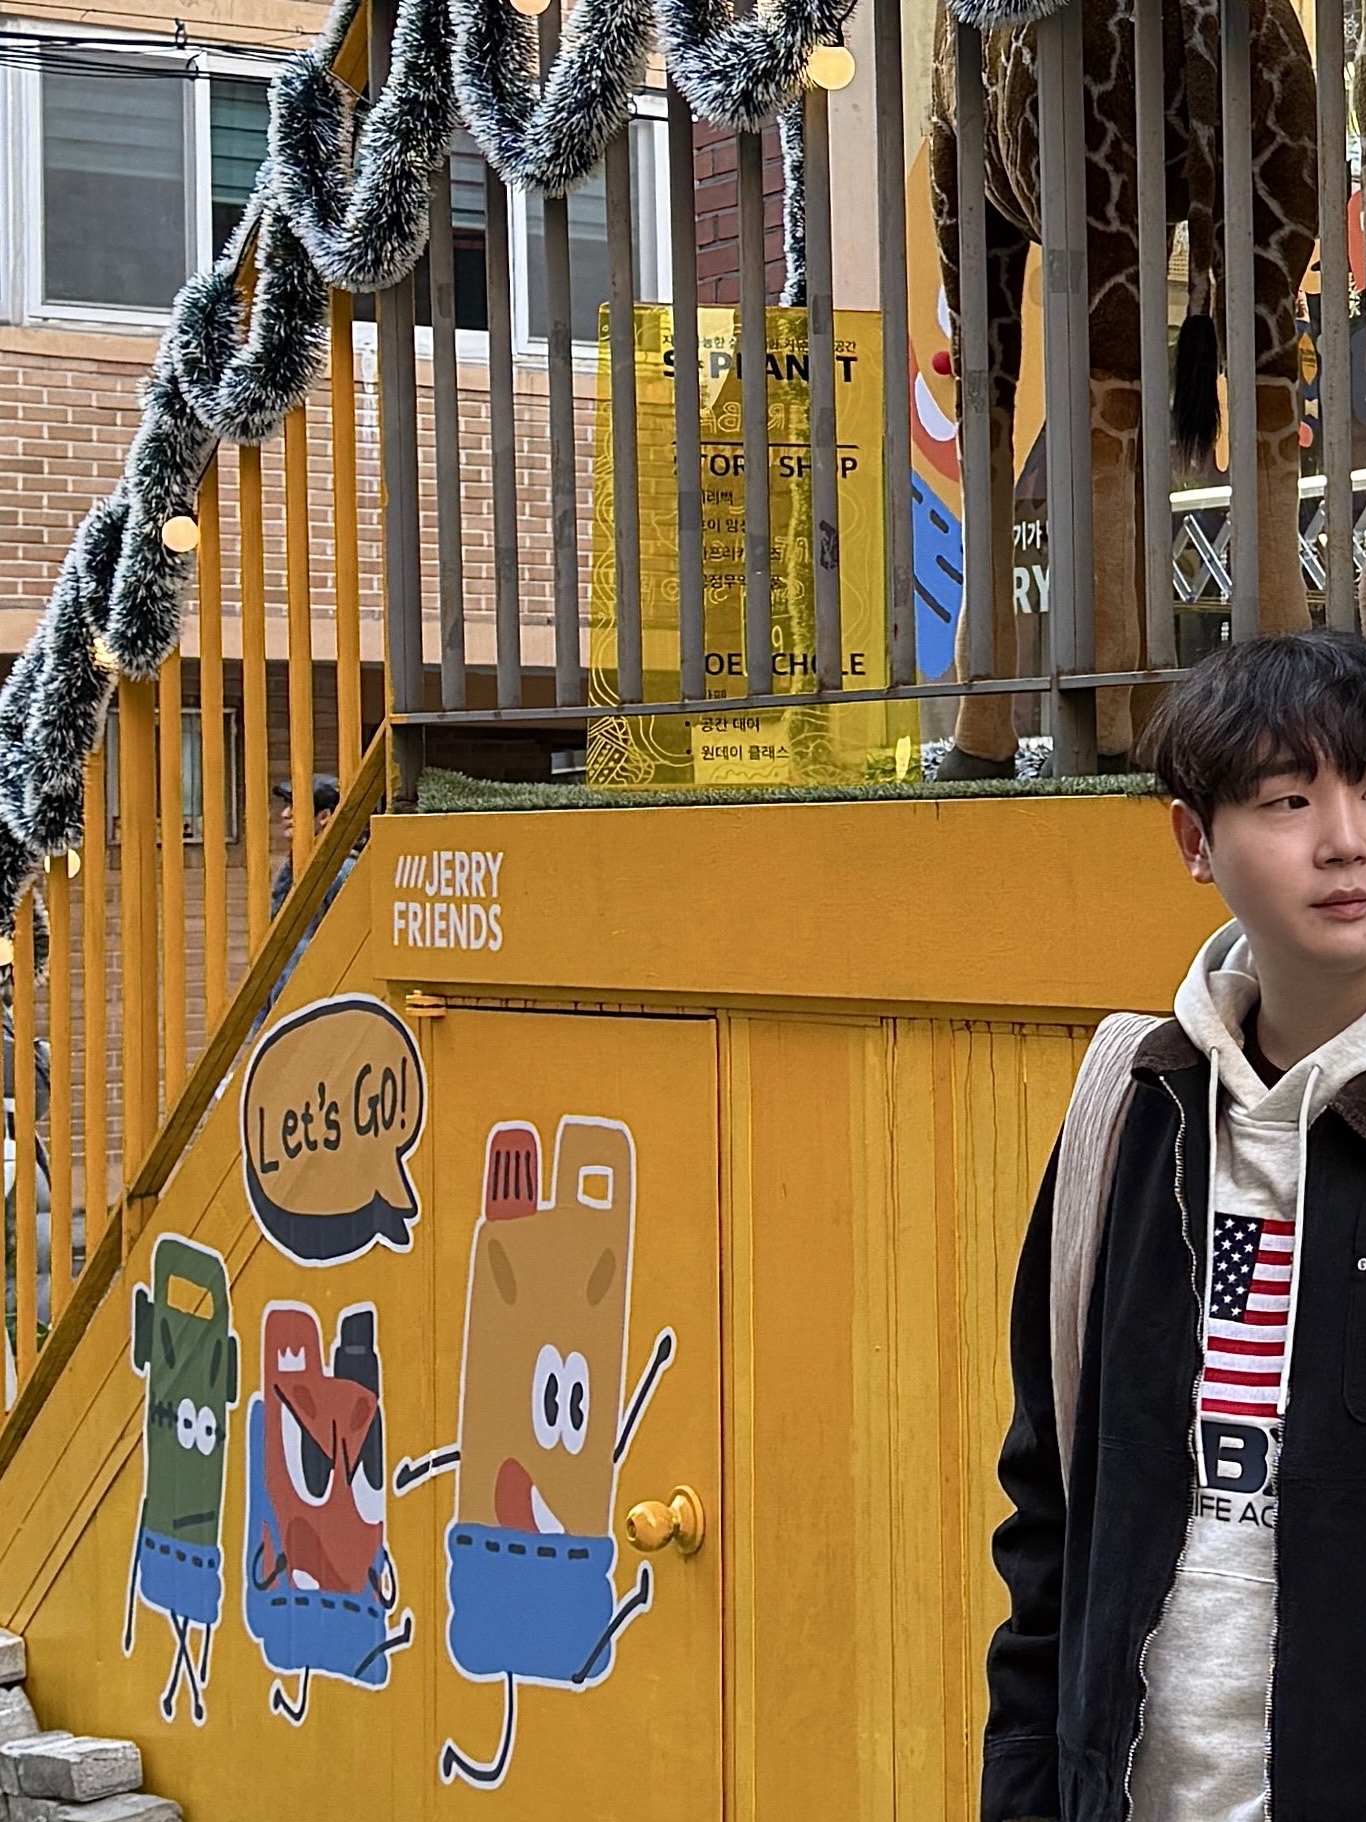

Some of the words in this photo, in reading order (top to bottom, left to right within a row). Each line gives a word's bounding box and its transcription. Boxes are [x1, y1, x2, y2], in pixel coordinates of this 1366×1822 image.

[779, 455, 858, 479] SHP
[701, 717, 728, 732] 공간
[701, 746, 743, 761] 원데이
[748, 745, 790, 761] 클래스
[425, 850, 504, 898] JERRY
[393, 901, 503, 951] FRIENDS
[259, 1081, 341, 1174] Let's
